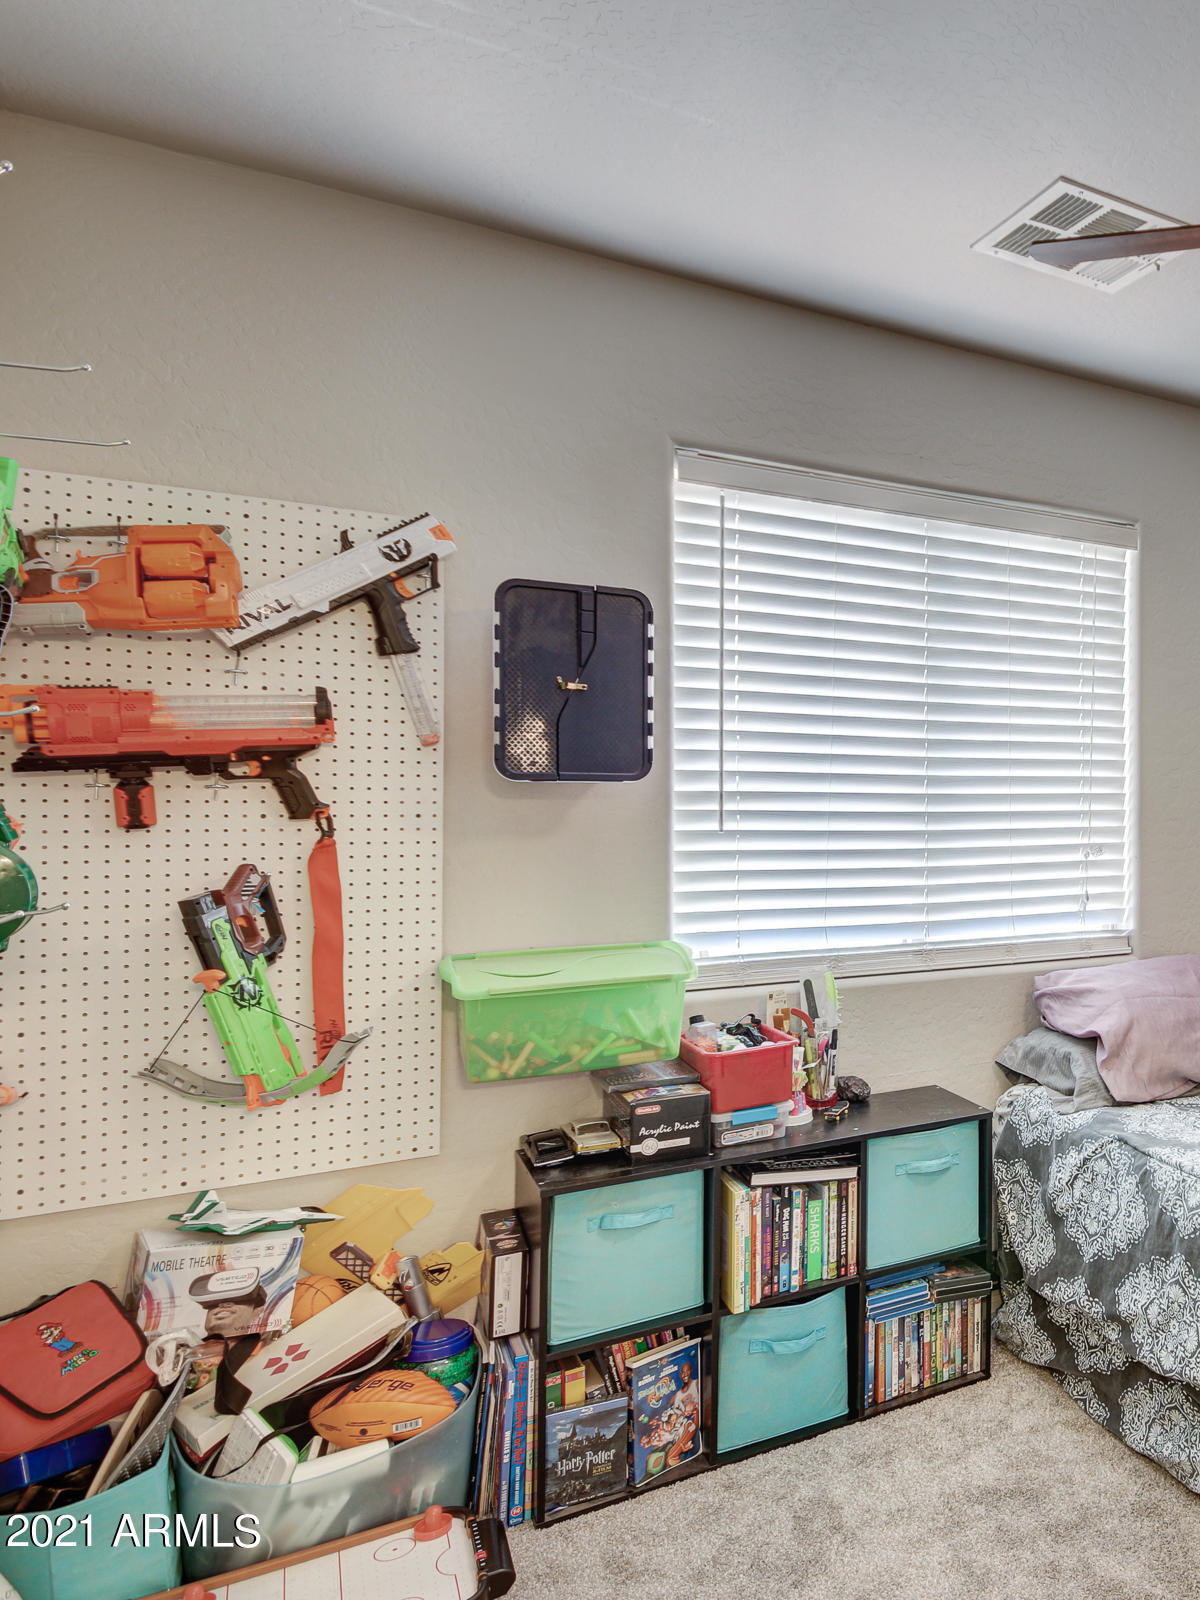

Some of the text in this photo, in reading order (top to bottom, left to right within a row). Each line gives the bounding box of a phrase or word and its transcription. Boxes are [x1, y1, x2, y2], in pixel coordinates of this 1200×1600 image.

[639, 1120, 701, 1137] Acrylic Paint
[809, 1207, 820, 1254] SHARKS
[151, 1254, 228, 1273] MOBILE THEATRE
[514, 1401, 526, 1429] Believe
[555, 1449, 617, 1477] Harry Potter
